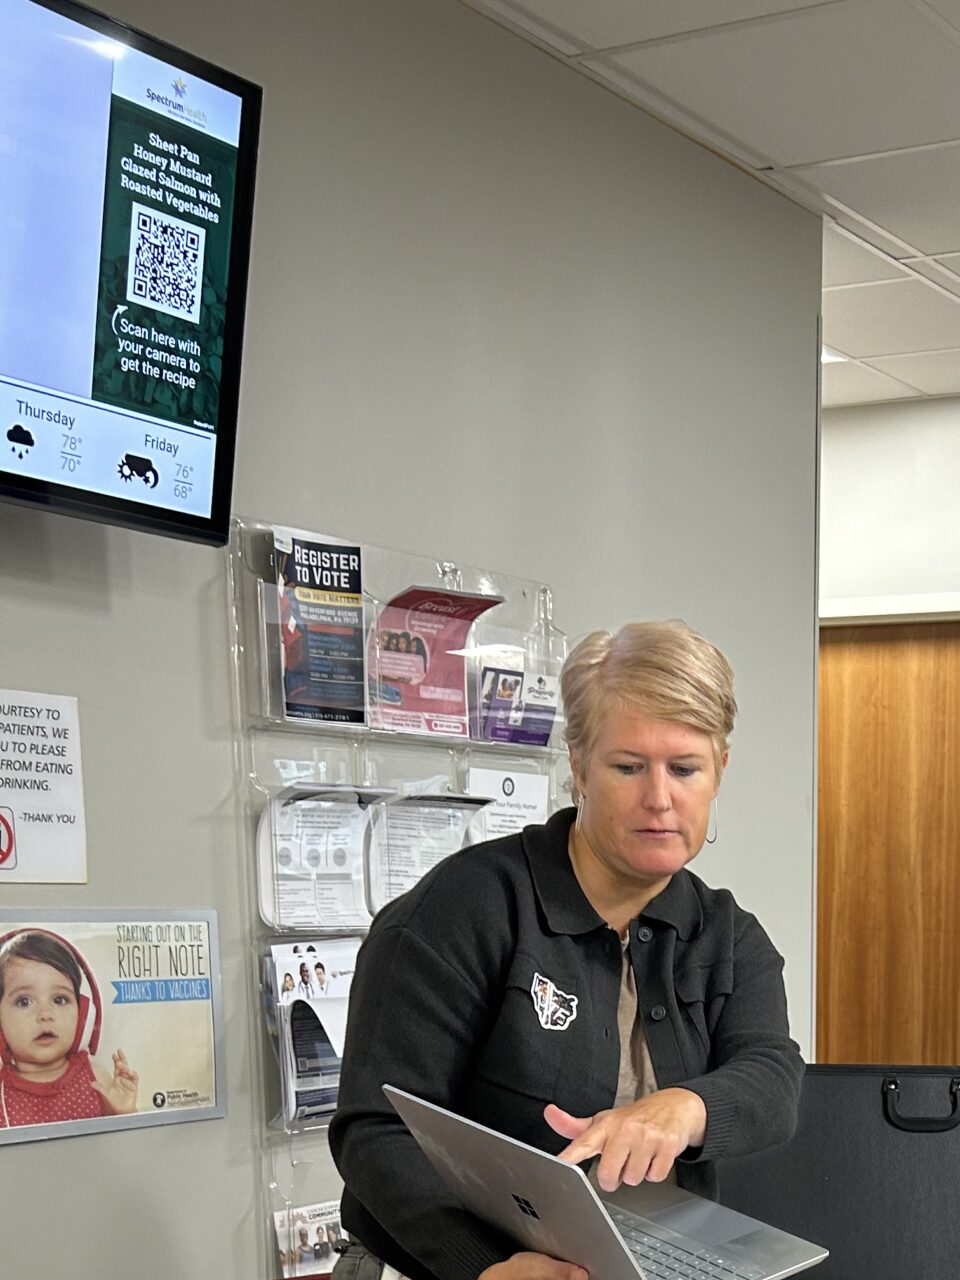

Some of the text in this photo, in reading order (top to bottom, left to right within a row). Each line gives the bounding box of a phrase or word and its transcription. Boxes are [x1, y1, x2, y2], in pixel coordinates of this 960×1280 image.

[149, 132, 200, 165] Sheet Pan
[133, 144, 212, 187] Honey Mustard
[121, 157, 221, 208] Glazed Salmon with
[121, 174, 219, 223] Roasted Vegetables
[120, 318, 201, 356] Scan here with
[118, 338, 200, 373] your camera to
[121, 356, 196, 389] get the recipe
[16, 399, 75, 430] Thursday
[61, 434, 82, 451] 78°
[144, 434, 180, 457] Friday
[60, 456, 81, 473] 70°
[175, 462, 194, 480] 76°
[174, 484, 192, 500] 68°
[294, 545, 359, 571] REGISTER
[295, 565, 350, 588] TO VOTE
[0, 704, 60, 721] URTESY TO
[52, 727, 70, 740] WE
[12, 741, 27, 753] TO
[29, 743, 67, 757] PLEASE
[0, 758, 73, 775] FROM EATING
[55, 814, 76, 824] YOU
[116, 924, 203, 943] STARTING OUT ON THE
[117, 944, 206, 978] RIGHT NOTE
[119, 980, 208, 1001] THANKS TO VACCINES
